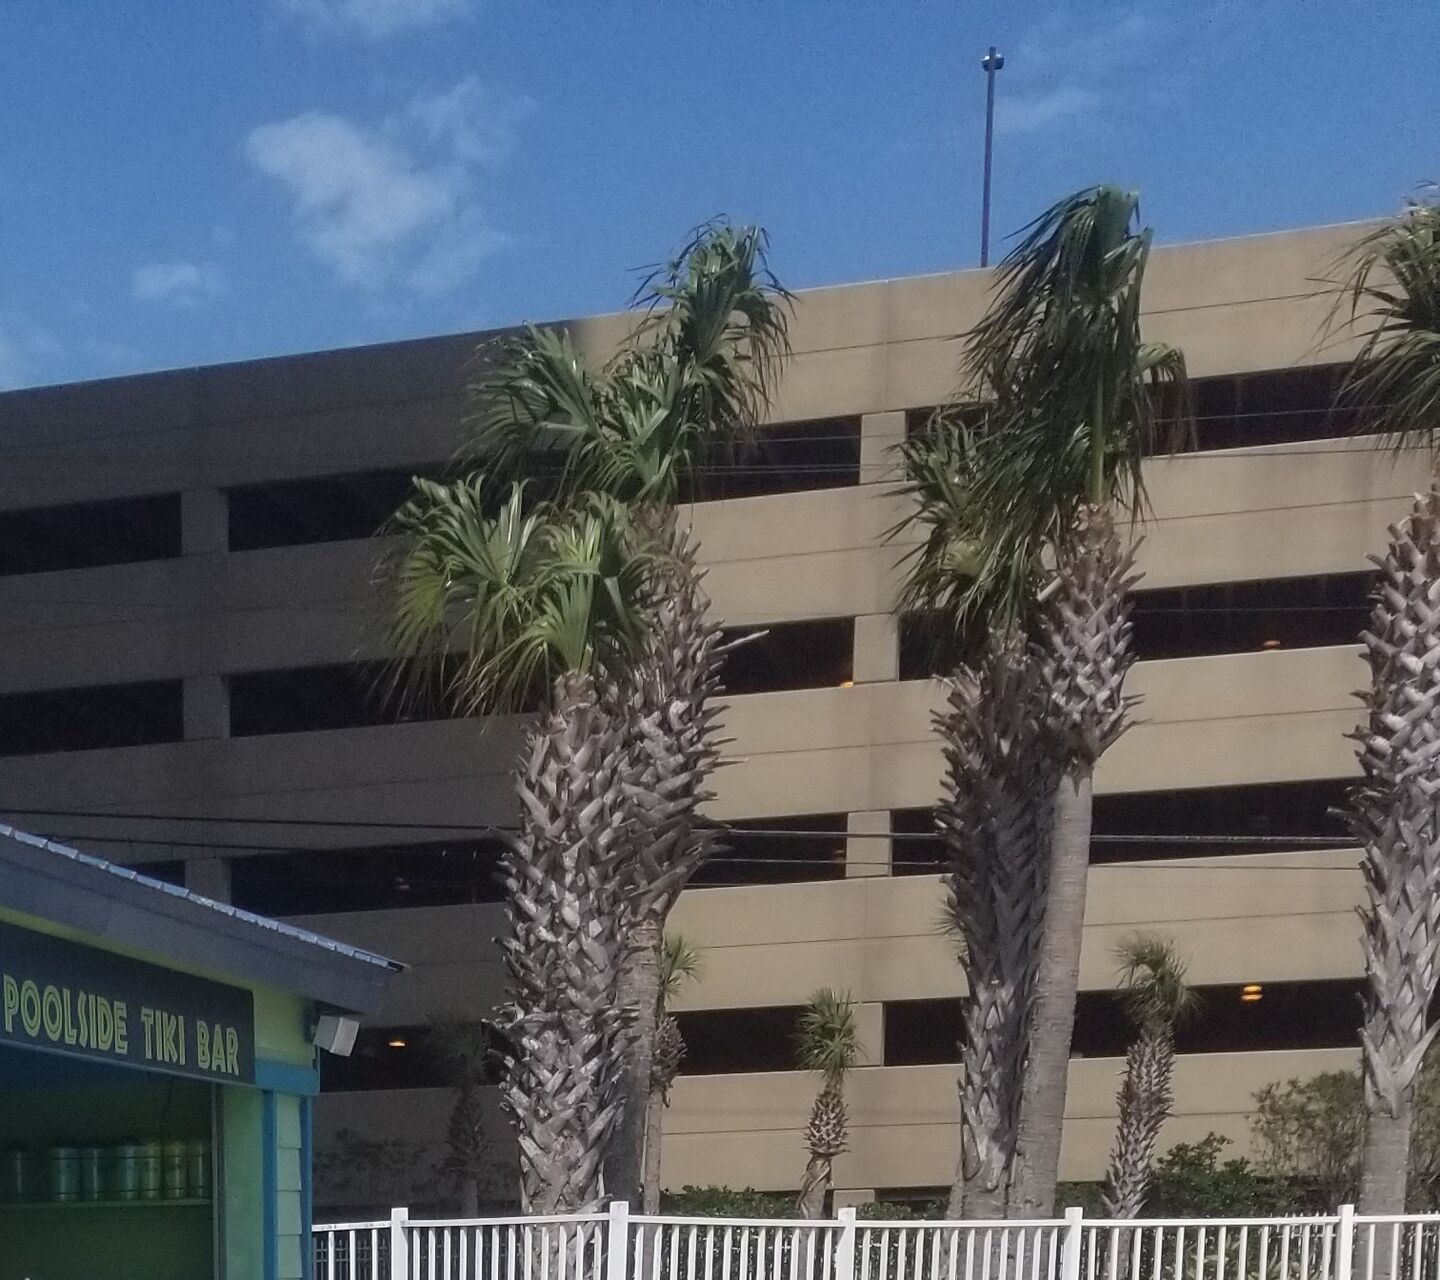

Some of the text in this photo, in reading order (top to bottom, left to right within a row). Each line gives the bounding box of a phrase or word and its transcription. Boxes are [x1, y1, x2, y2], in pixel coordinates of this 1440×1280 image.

[3, 973, 128, 1054] POOLSIDE
[141, 1005, 186, 1066] TIKI
[196, 1020, 240, 1076] BAR
